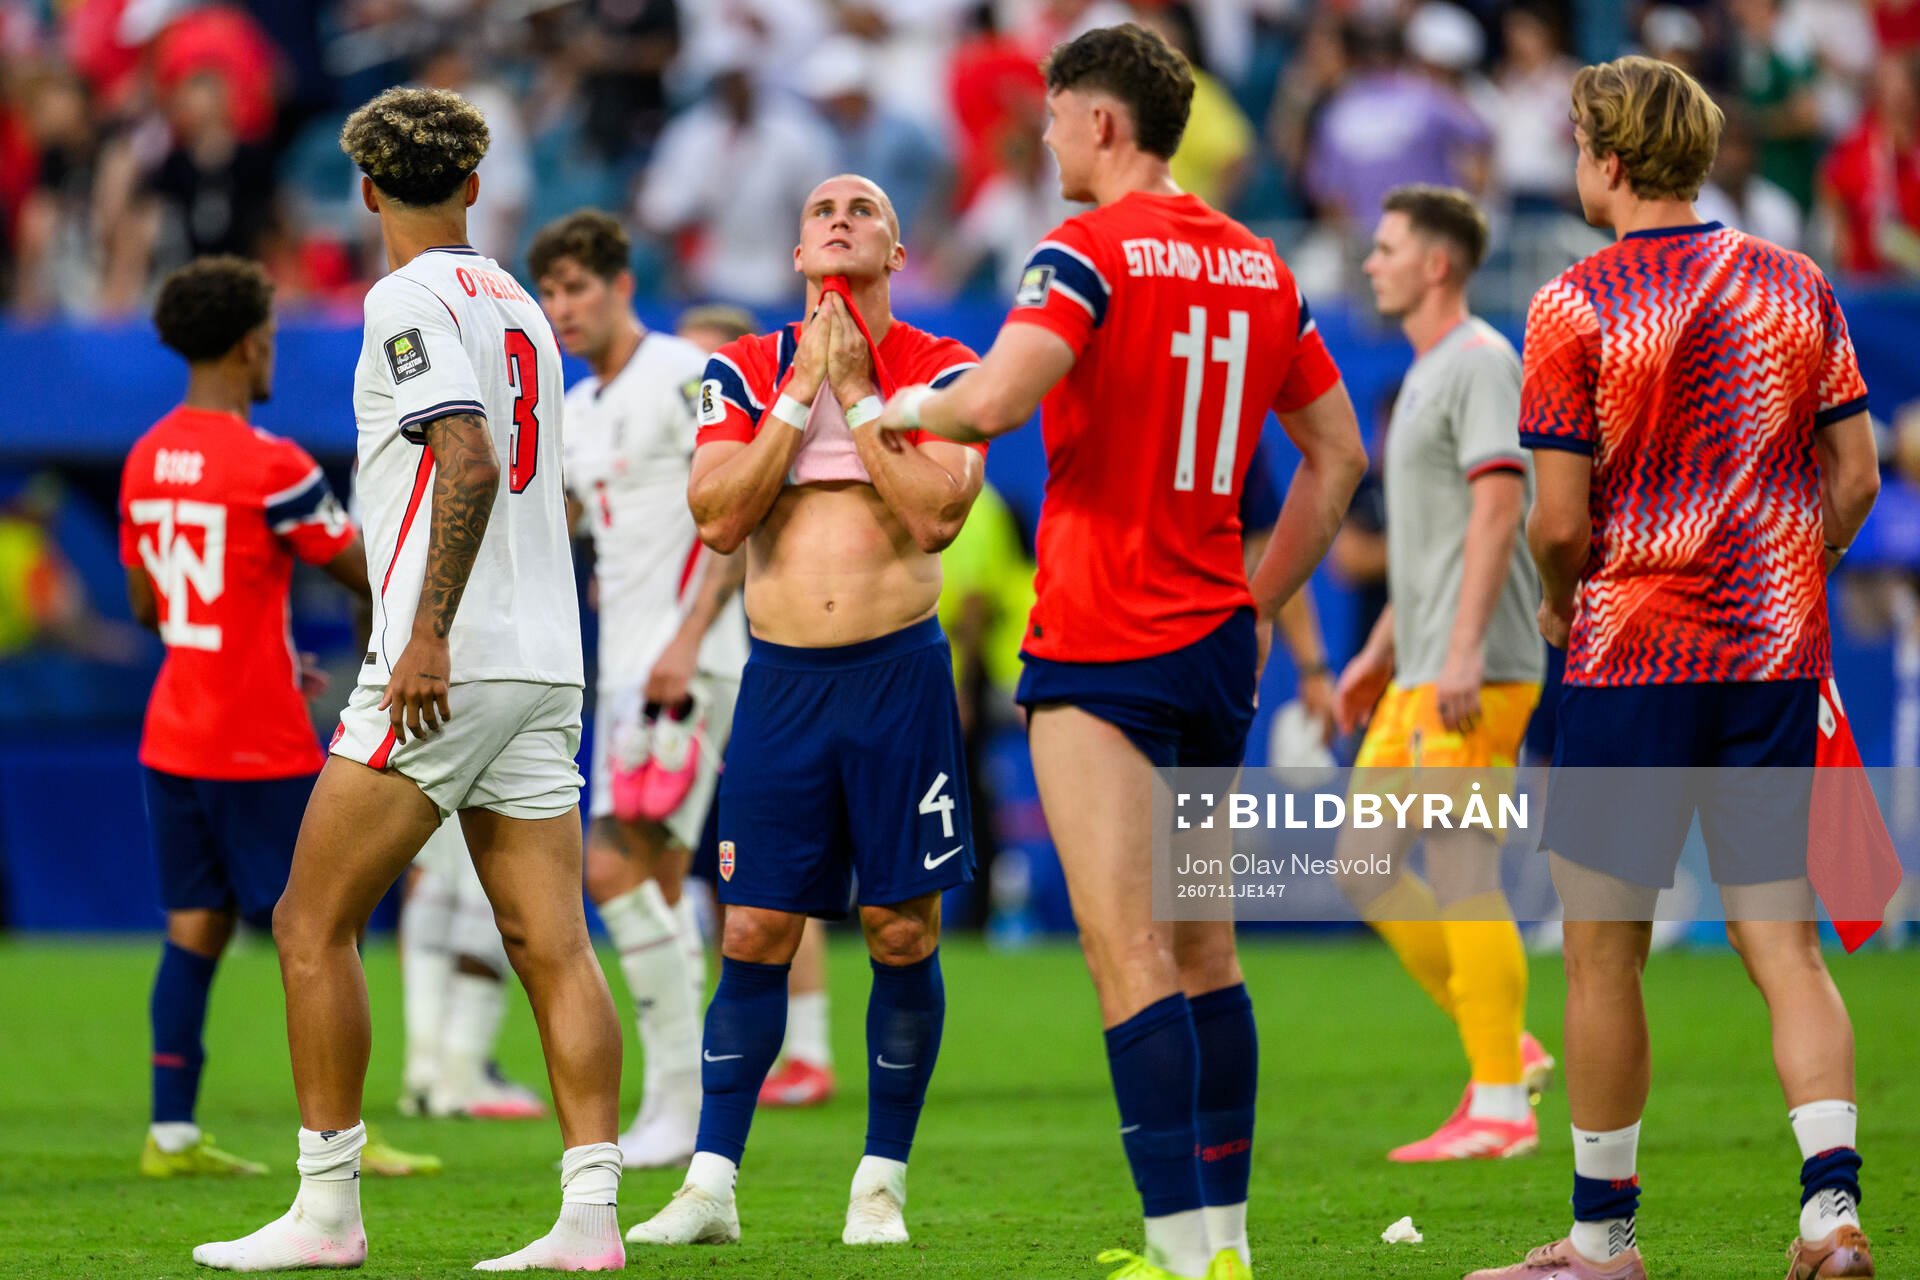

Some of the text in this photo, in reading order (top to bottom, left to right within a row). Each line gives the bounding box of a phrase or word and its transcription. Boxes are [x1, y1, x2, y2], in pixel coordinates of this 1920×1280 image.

[1121, 238, 1279, 290] STRAND LARSEN
[504, 328, 539, 494] 3
[1171, 305, 1249, 495] 11
[918, 771, 955, 838] 4
